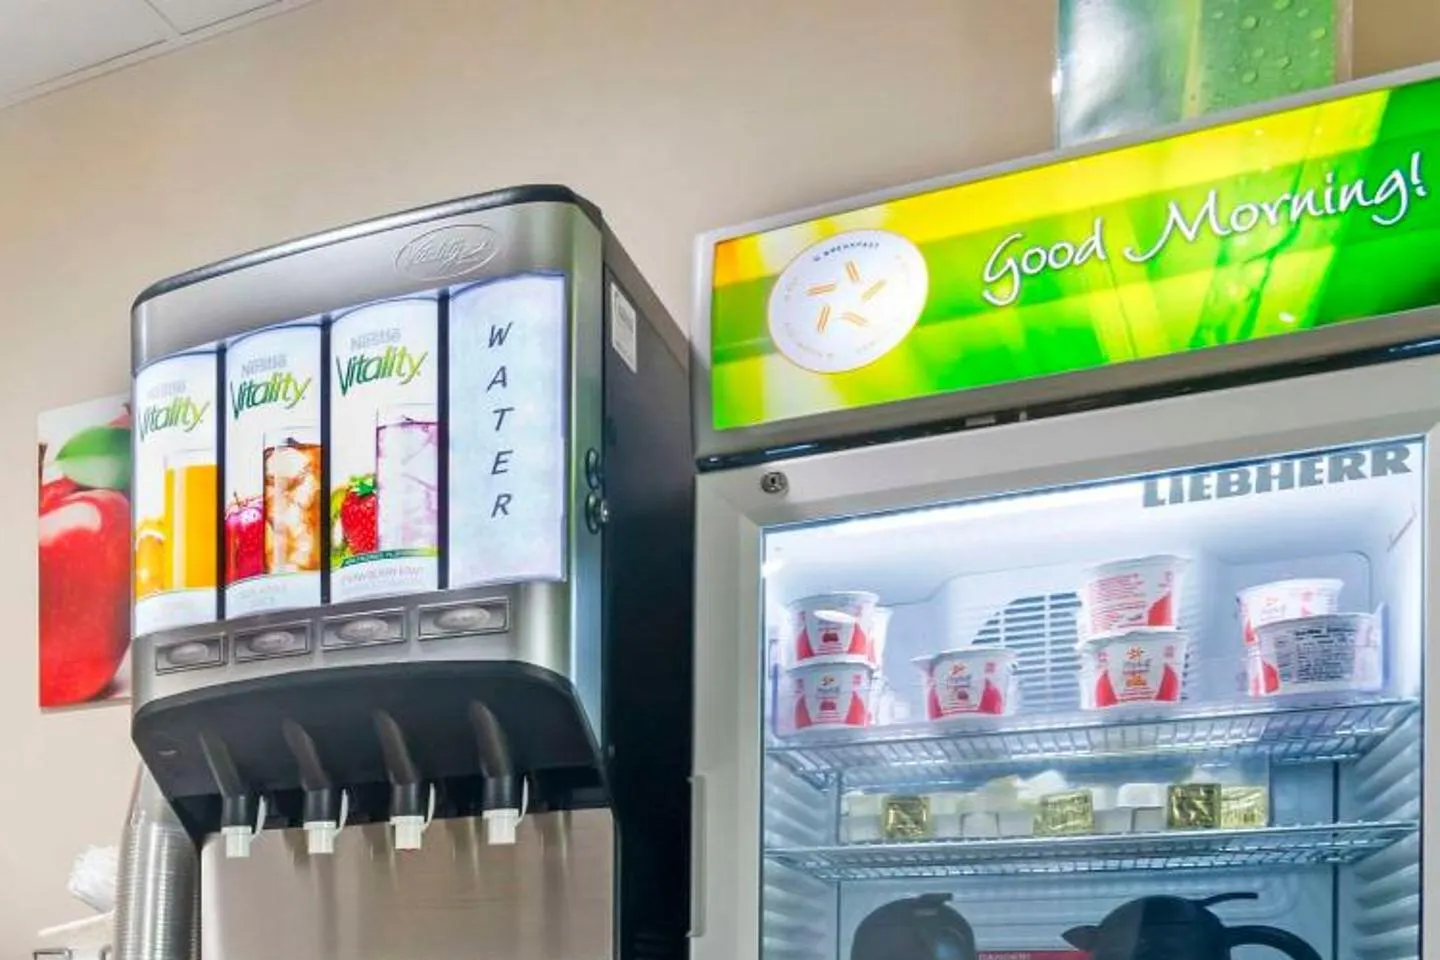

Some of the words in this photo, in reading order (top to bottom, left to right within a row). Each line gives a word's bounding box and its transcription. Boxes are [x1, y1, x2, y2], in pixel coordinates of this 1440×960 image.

[982, 216, 1107, 308] Good
[1123, 151, 1428, 263] Morning!
[230, 371, 312, 420] Vitality
[336, 345, 429, 397] Vitality
[138, 396, 211, 442] Vitality
[486, 321, 515, 518] WATER
[1143, 445, 1413, 507] LIEBHERR
